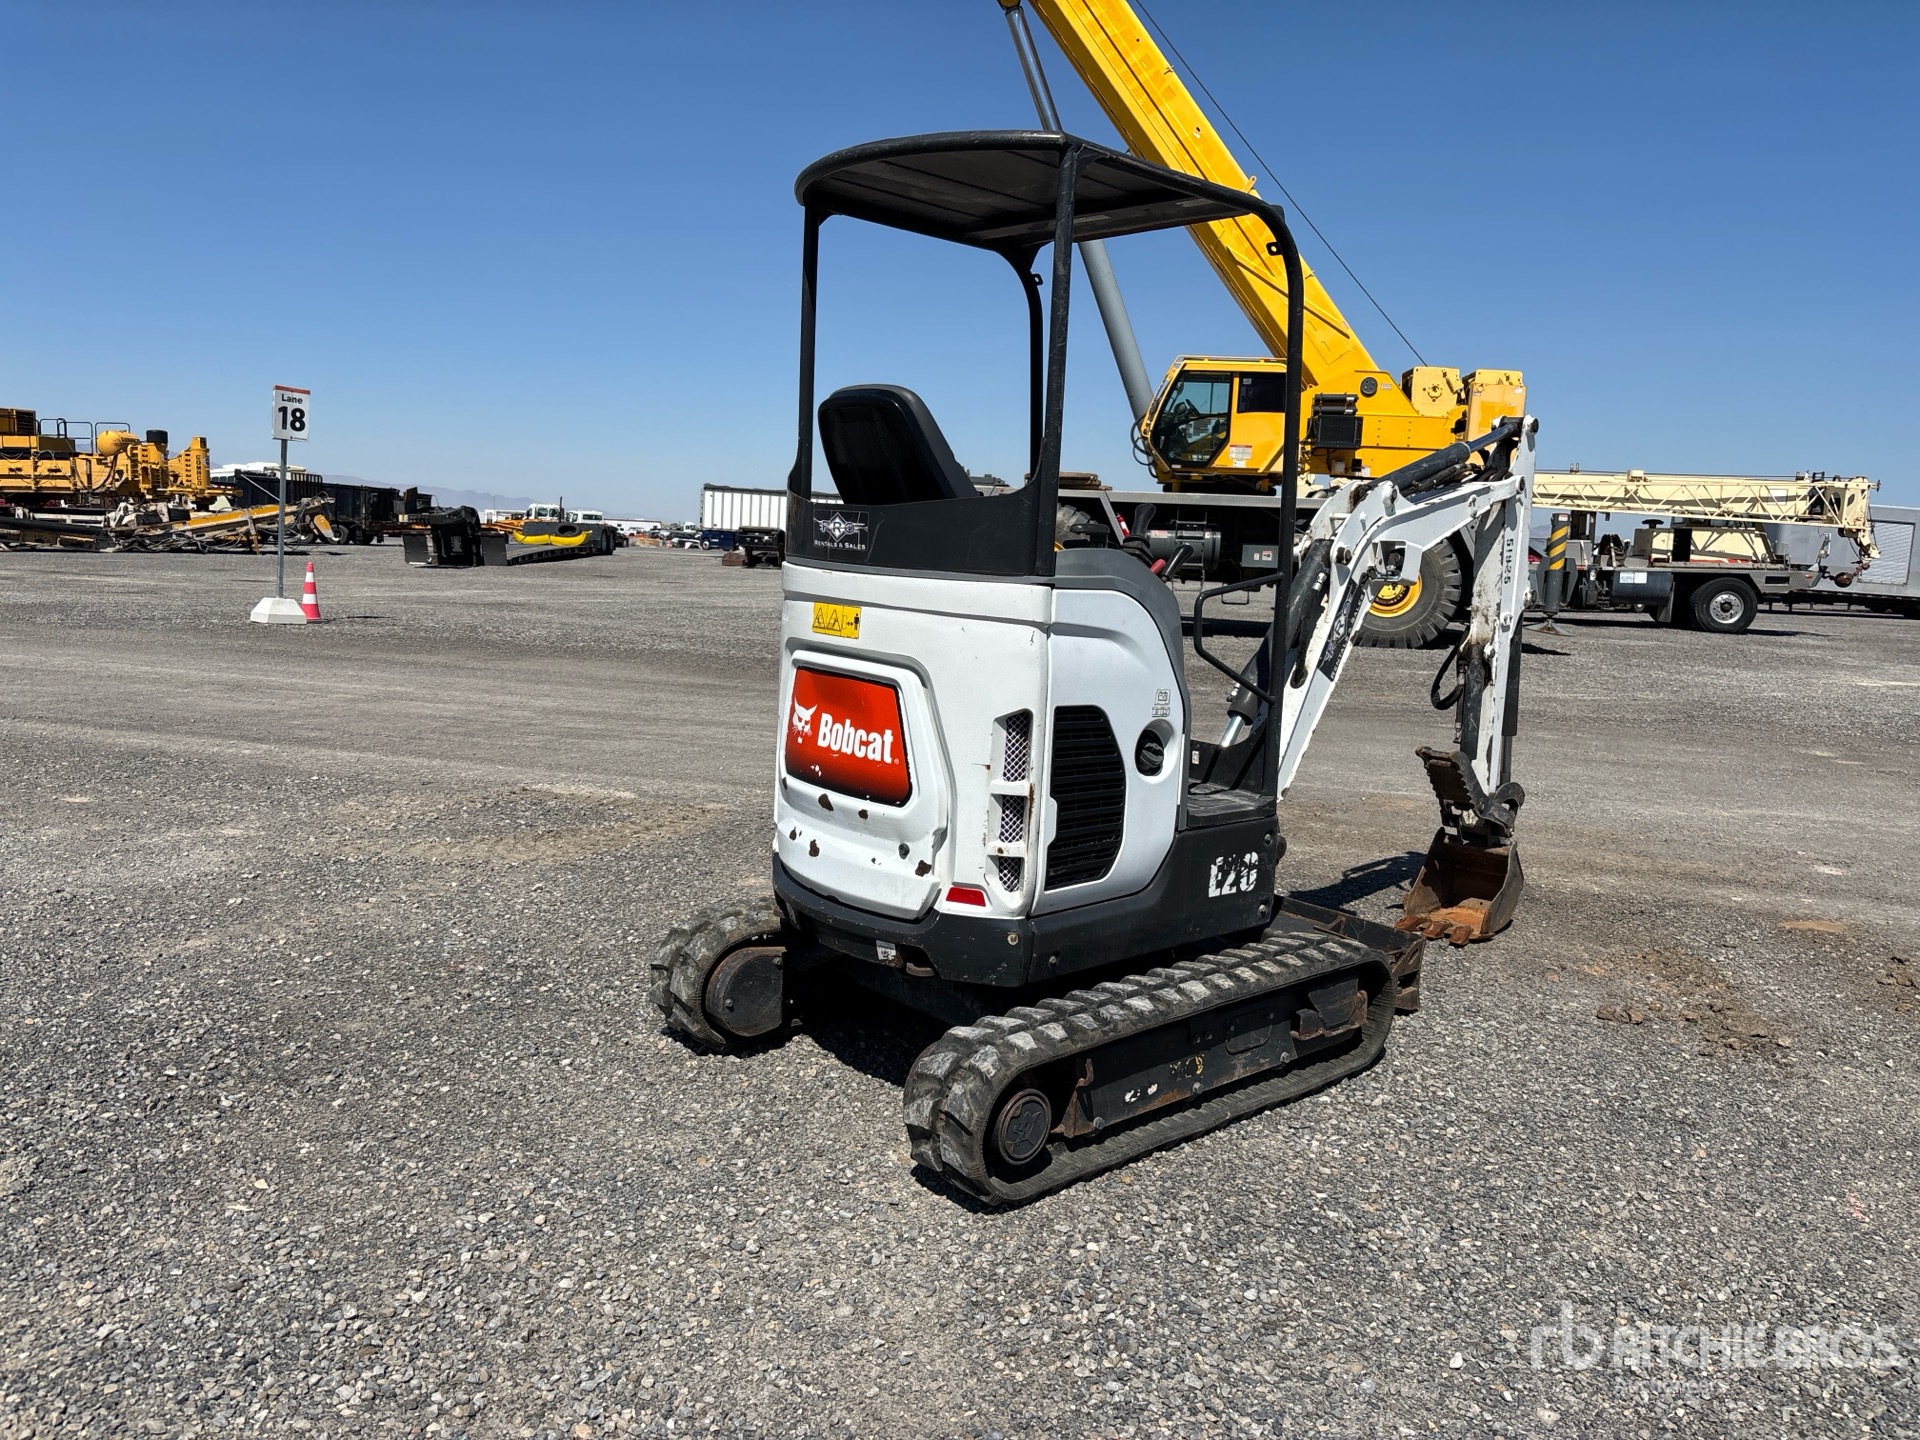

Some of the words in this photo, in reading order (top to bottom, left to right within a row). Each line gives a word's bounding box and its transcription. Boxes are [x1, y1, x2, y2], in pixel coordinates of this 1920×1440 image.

[281, 393, 303, 404] Lane
[278, 405, 306, 432] 18
[844, 542, 866, 550] SALES
[817, 712, 894, 764] Bobcat
